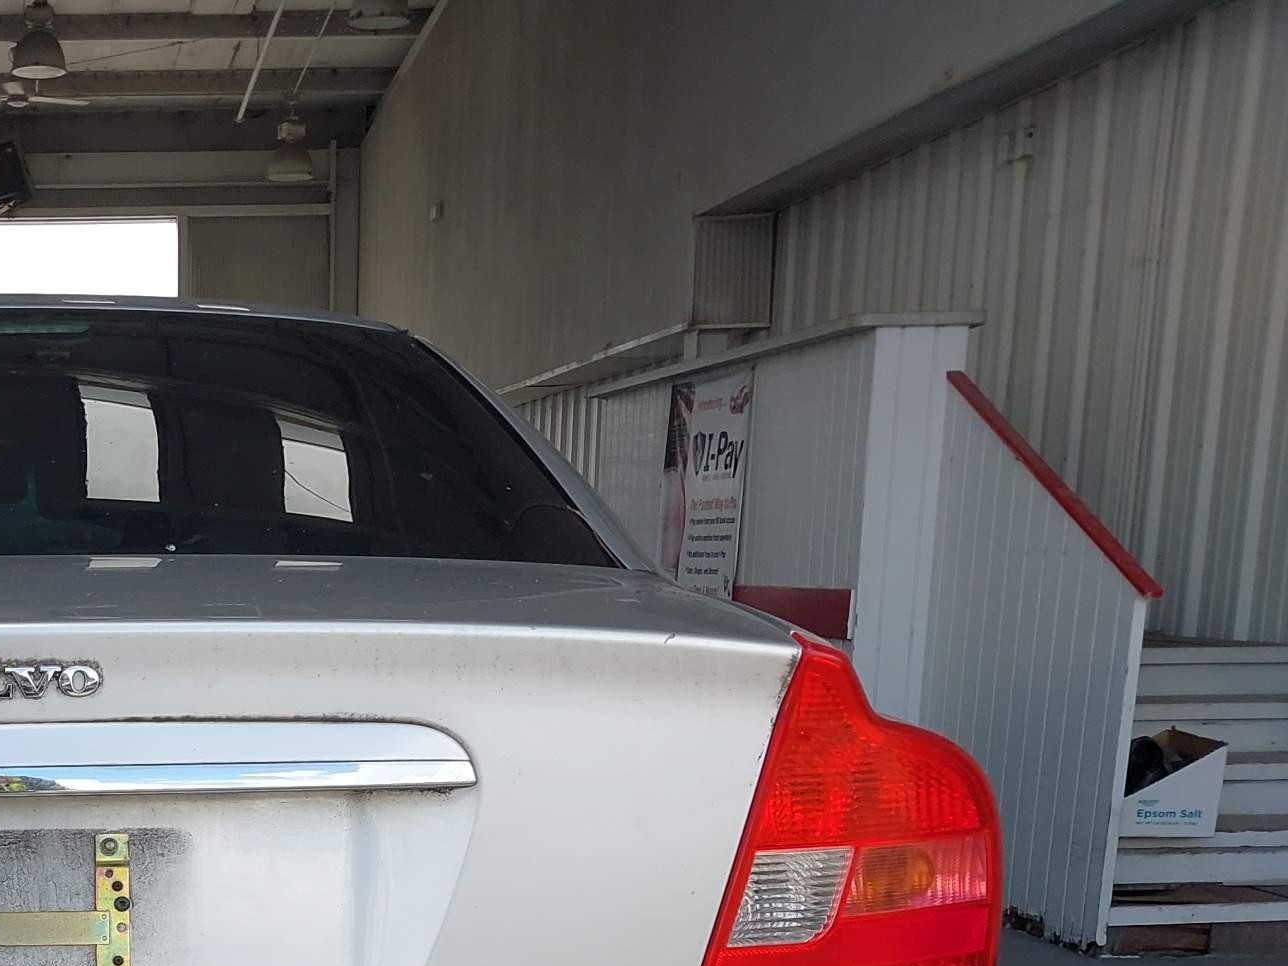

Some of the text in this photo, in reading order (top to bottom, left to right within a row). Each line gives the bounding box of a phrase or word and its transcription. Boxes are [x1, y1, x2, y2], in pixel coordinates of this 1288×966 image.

[703, 431, 745, 478] I-Pay
[1136, 809, 1203, 819] Epsom Salt
